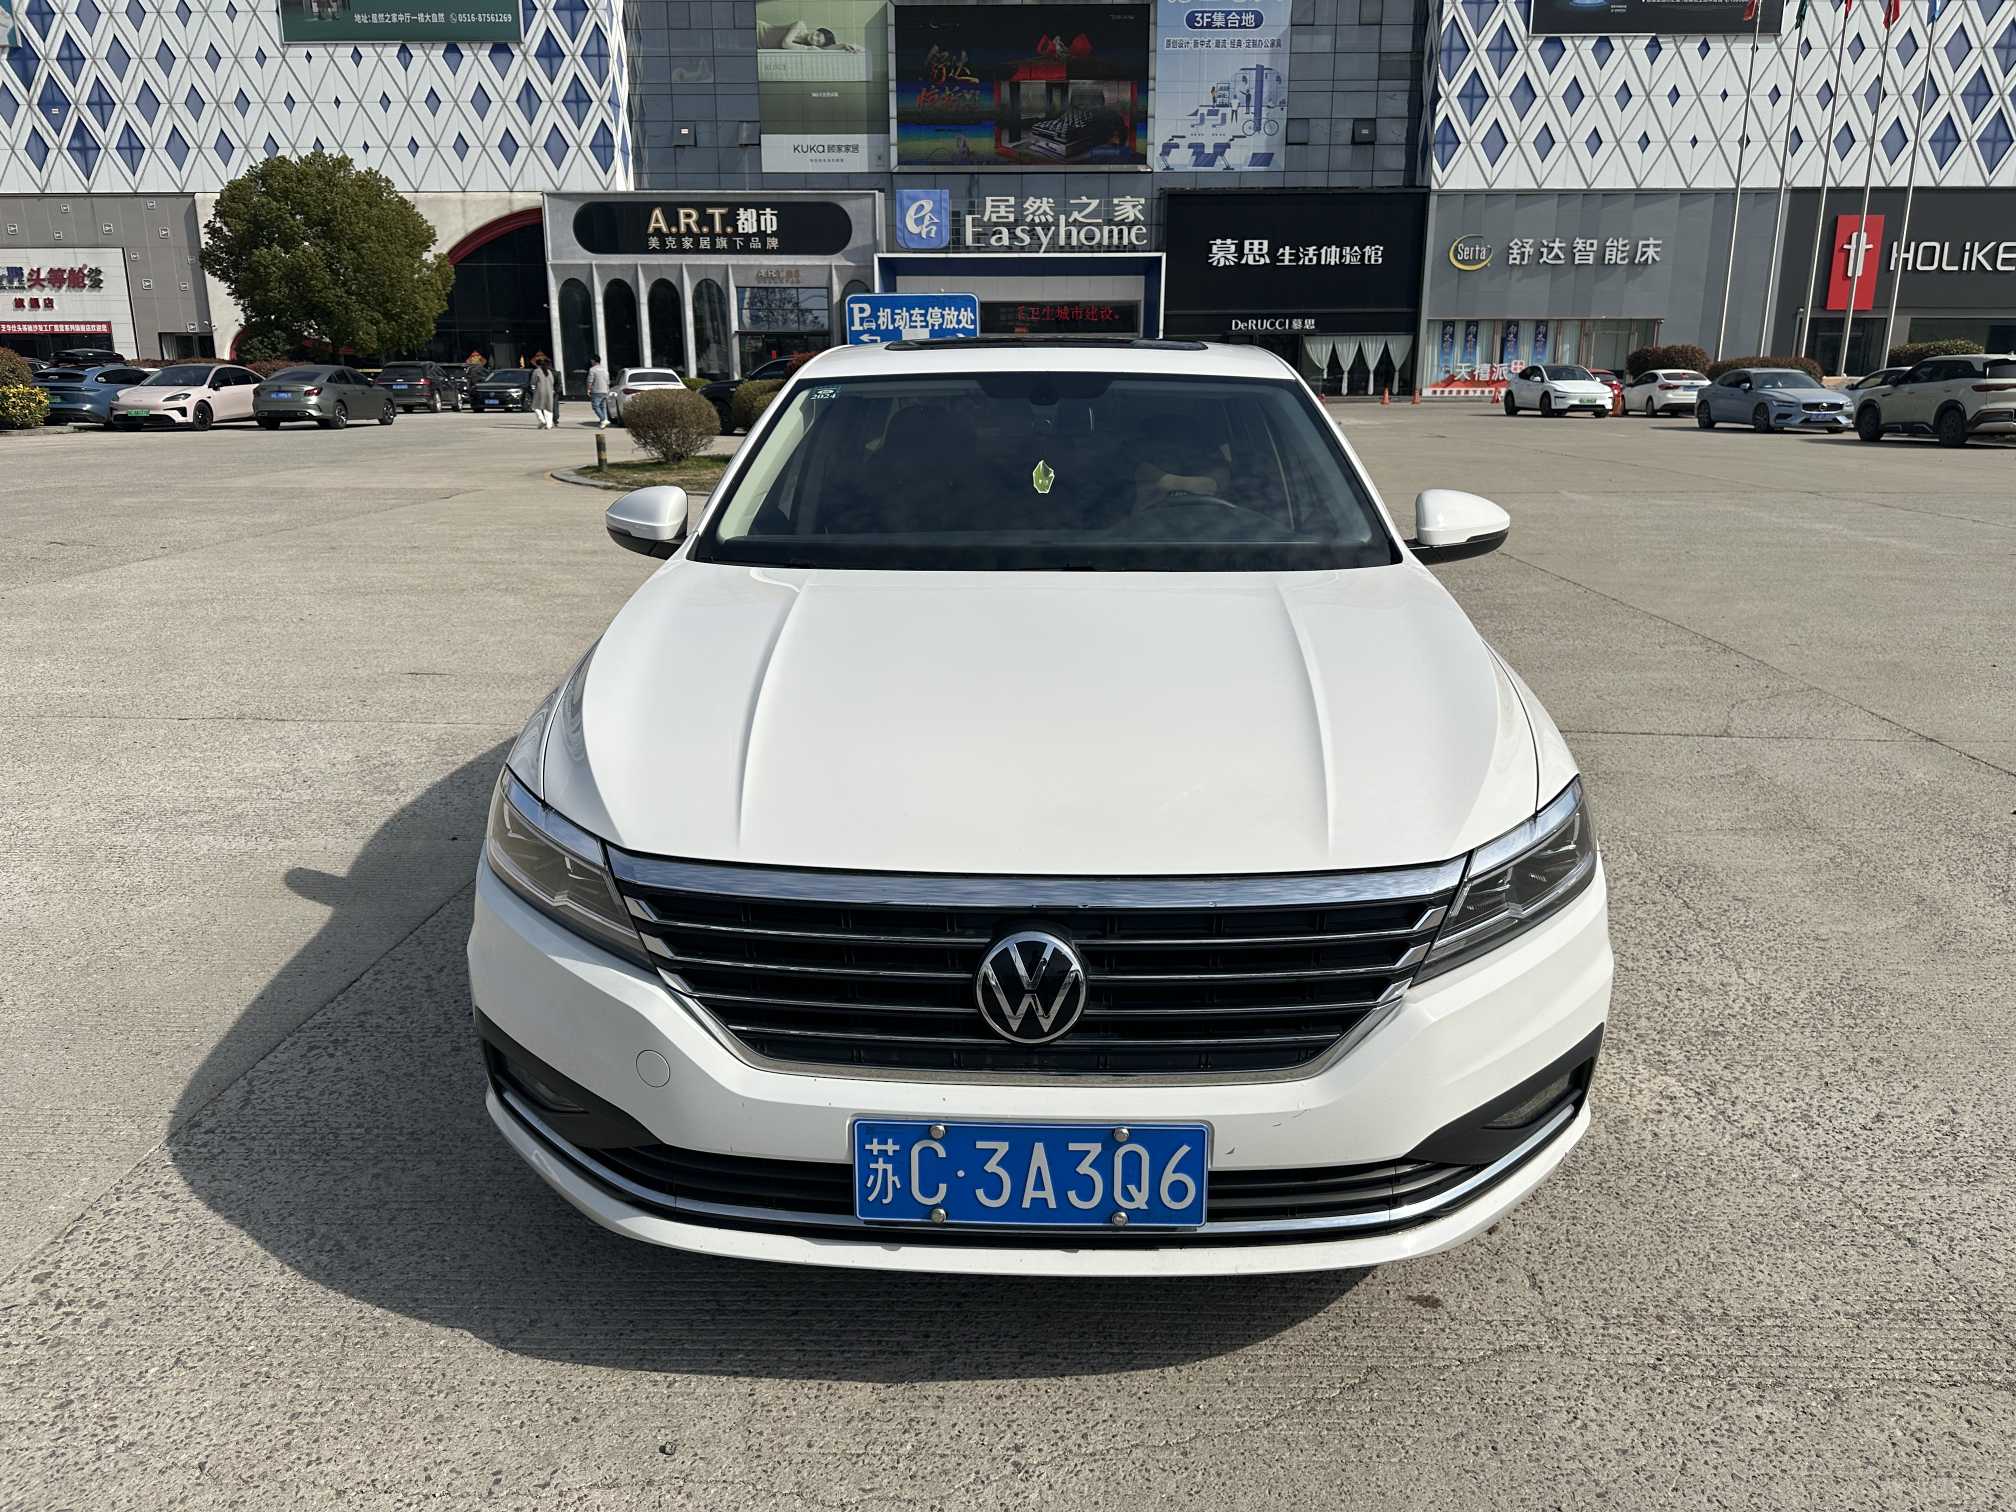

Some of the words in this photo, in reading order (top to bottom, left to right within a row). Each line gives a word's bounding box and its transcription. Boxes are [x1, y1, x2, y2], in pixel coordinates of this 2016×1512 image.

[1194, 11, 1256, 28] 3F集合地
[647, 207, 734, 234] A.R.T.
[736, 207, 778, 234] 都市
[983, 196, 1146, 224] 居然之家
[647, 236, 780, 250] 美克家居旗下品牌
[964, 214, 1148, 254] Easyhome
[1208, 238, 1271, 267] 慕思
[1275, 244, 1384, 266] 生活体验馆
[1457, 242, 1487, 261] Serta
[1508, 236, 1664, 266] 舒达智能床
[877, 307, 975, 330] 机动车停放处
[1231, 319, 1289, 330] DeRUCCI
